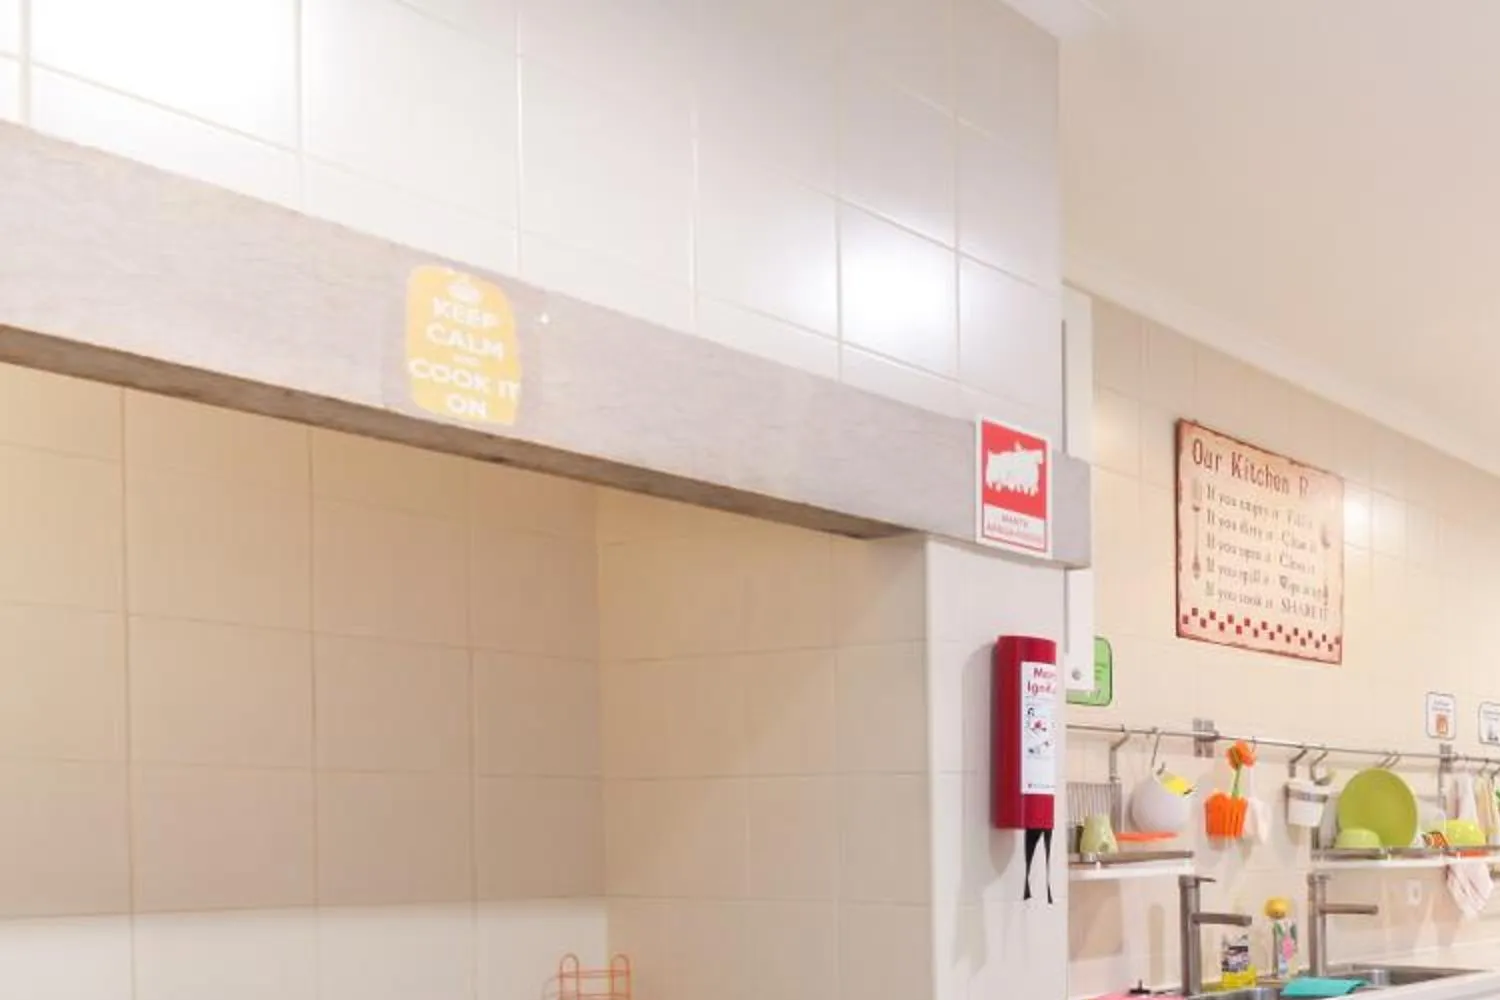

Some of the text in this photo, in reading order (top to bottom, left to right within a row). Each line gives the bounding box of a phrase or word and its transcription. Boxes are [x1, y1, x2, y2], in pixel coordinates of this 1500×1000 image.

[432, 295, 500, 328] KEEP
[425, 321, 503, 362] CALM
[407, 357, 521, 405] COOK IT
[446, 392, 488, 420] ON
[1193, 438, 1222, 472] Our
[1231, 451, 1289, 495] Kitchen
